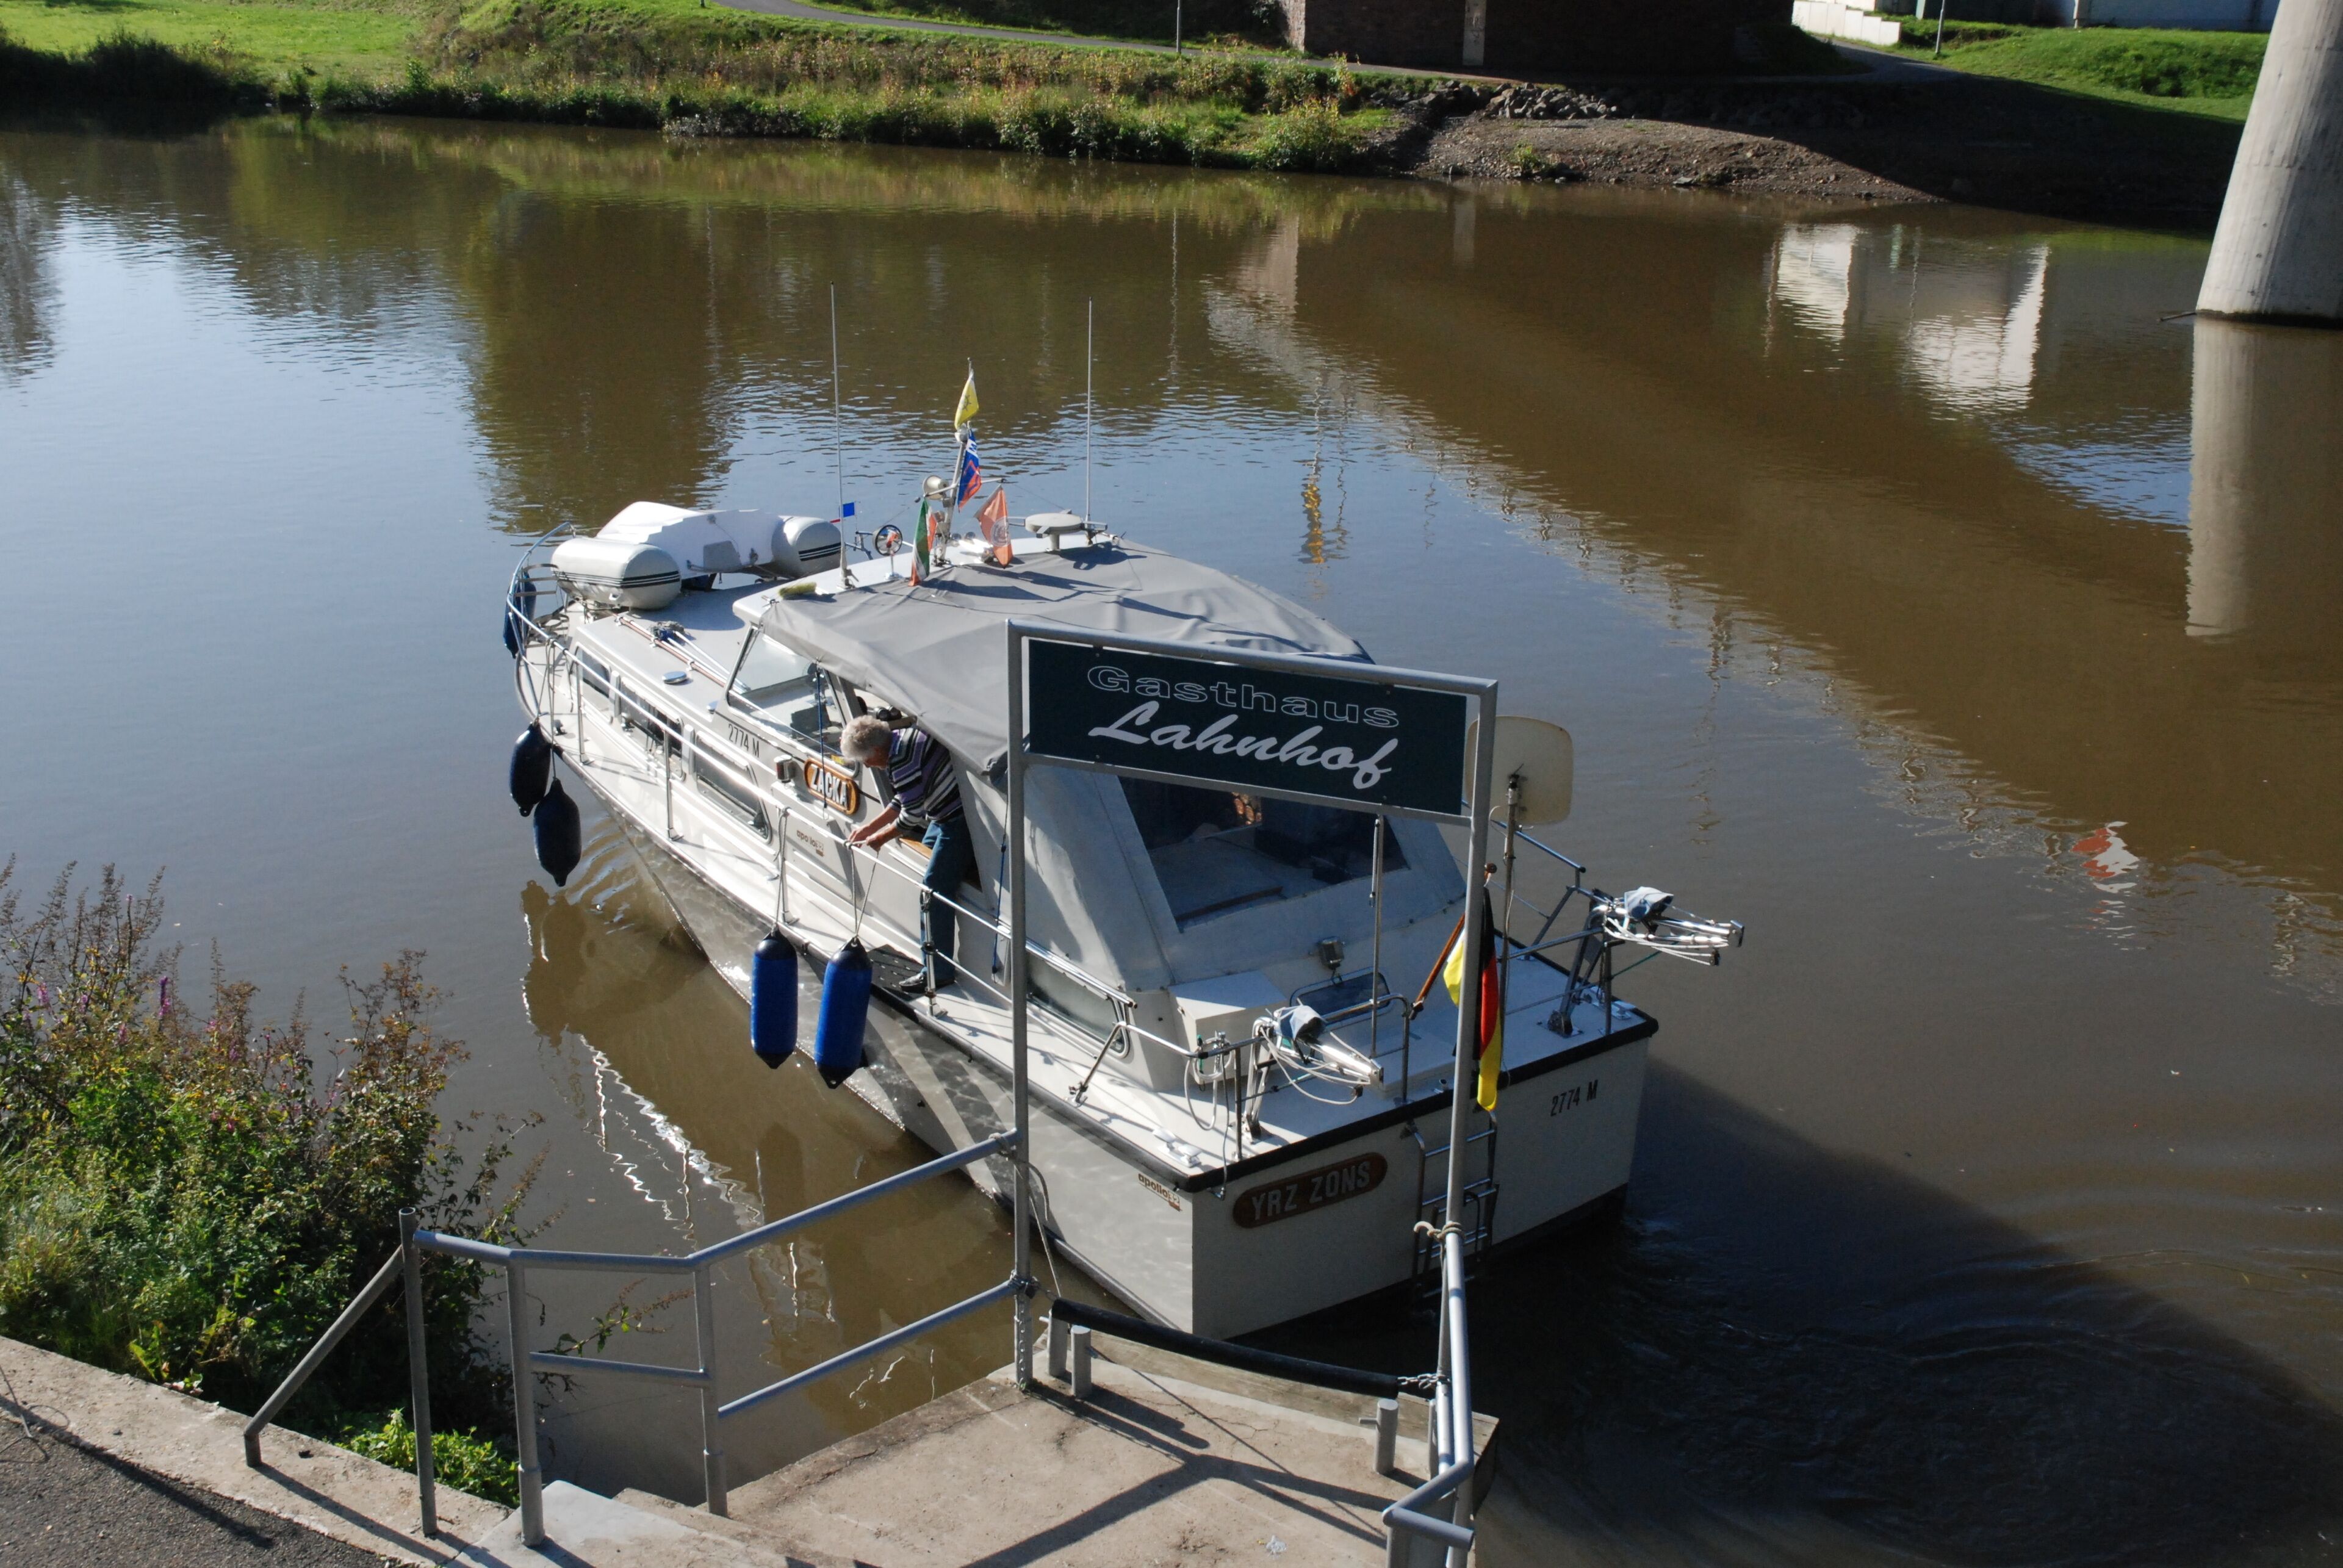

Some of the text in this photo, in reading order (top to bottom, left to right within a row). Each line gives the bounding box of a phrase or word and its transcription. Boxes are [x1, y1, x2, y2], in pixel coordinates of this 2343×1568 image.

[1087, 666, 1399, 728] Gasthaus
[728, 724, 760, 758] 2774 M
[1089, 701, 1398, 789] Lahnhof
[1550, 1079, 1598, 1117] 2774 M
[1252, 1161, 1370, 1220] YRZ ZONS
